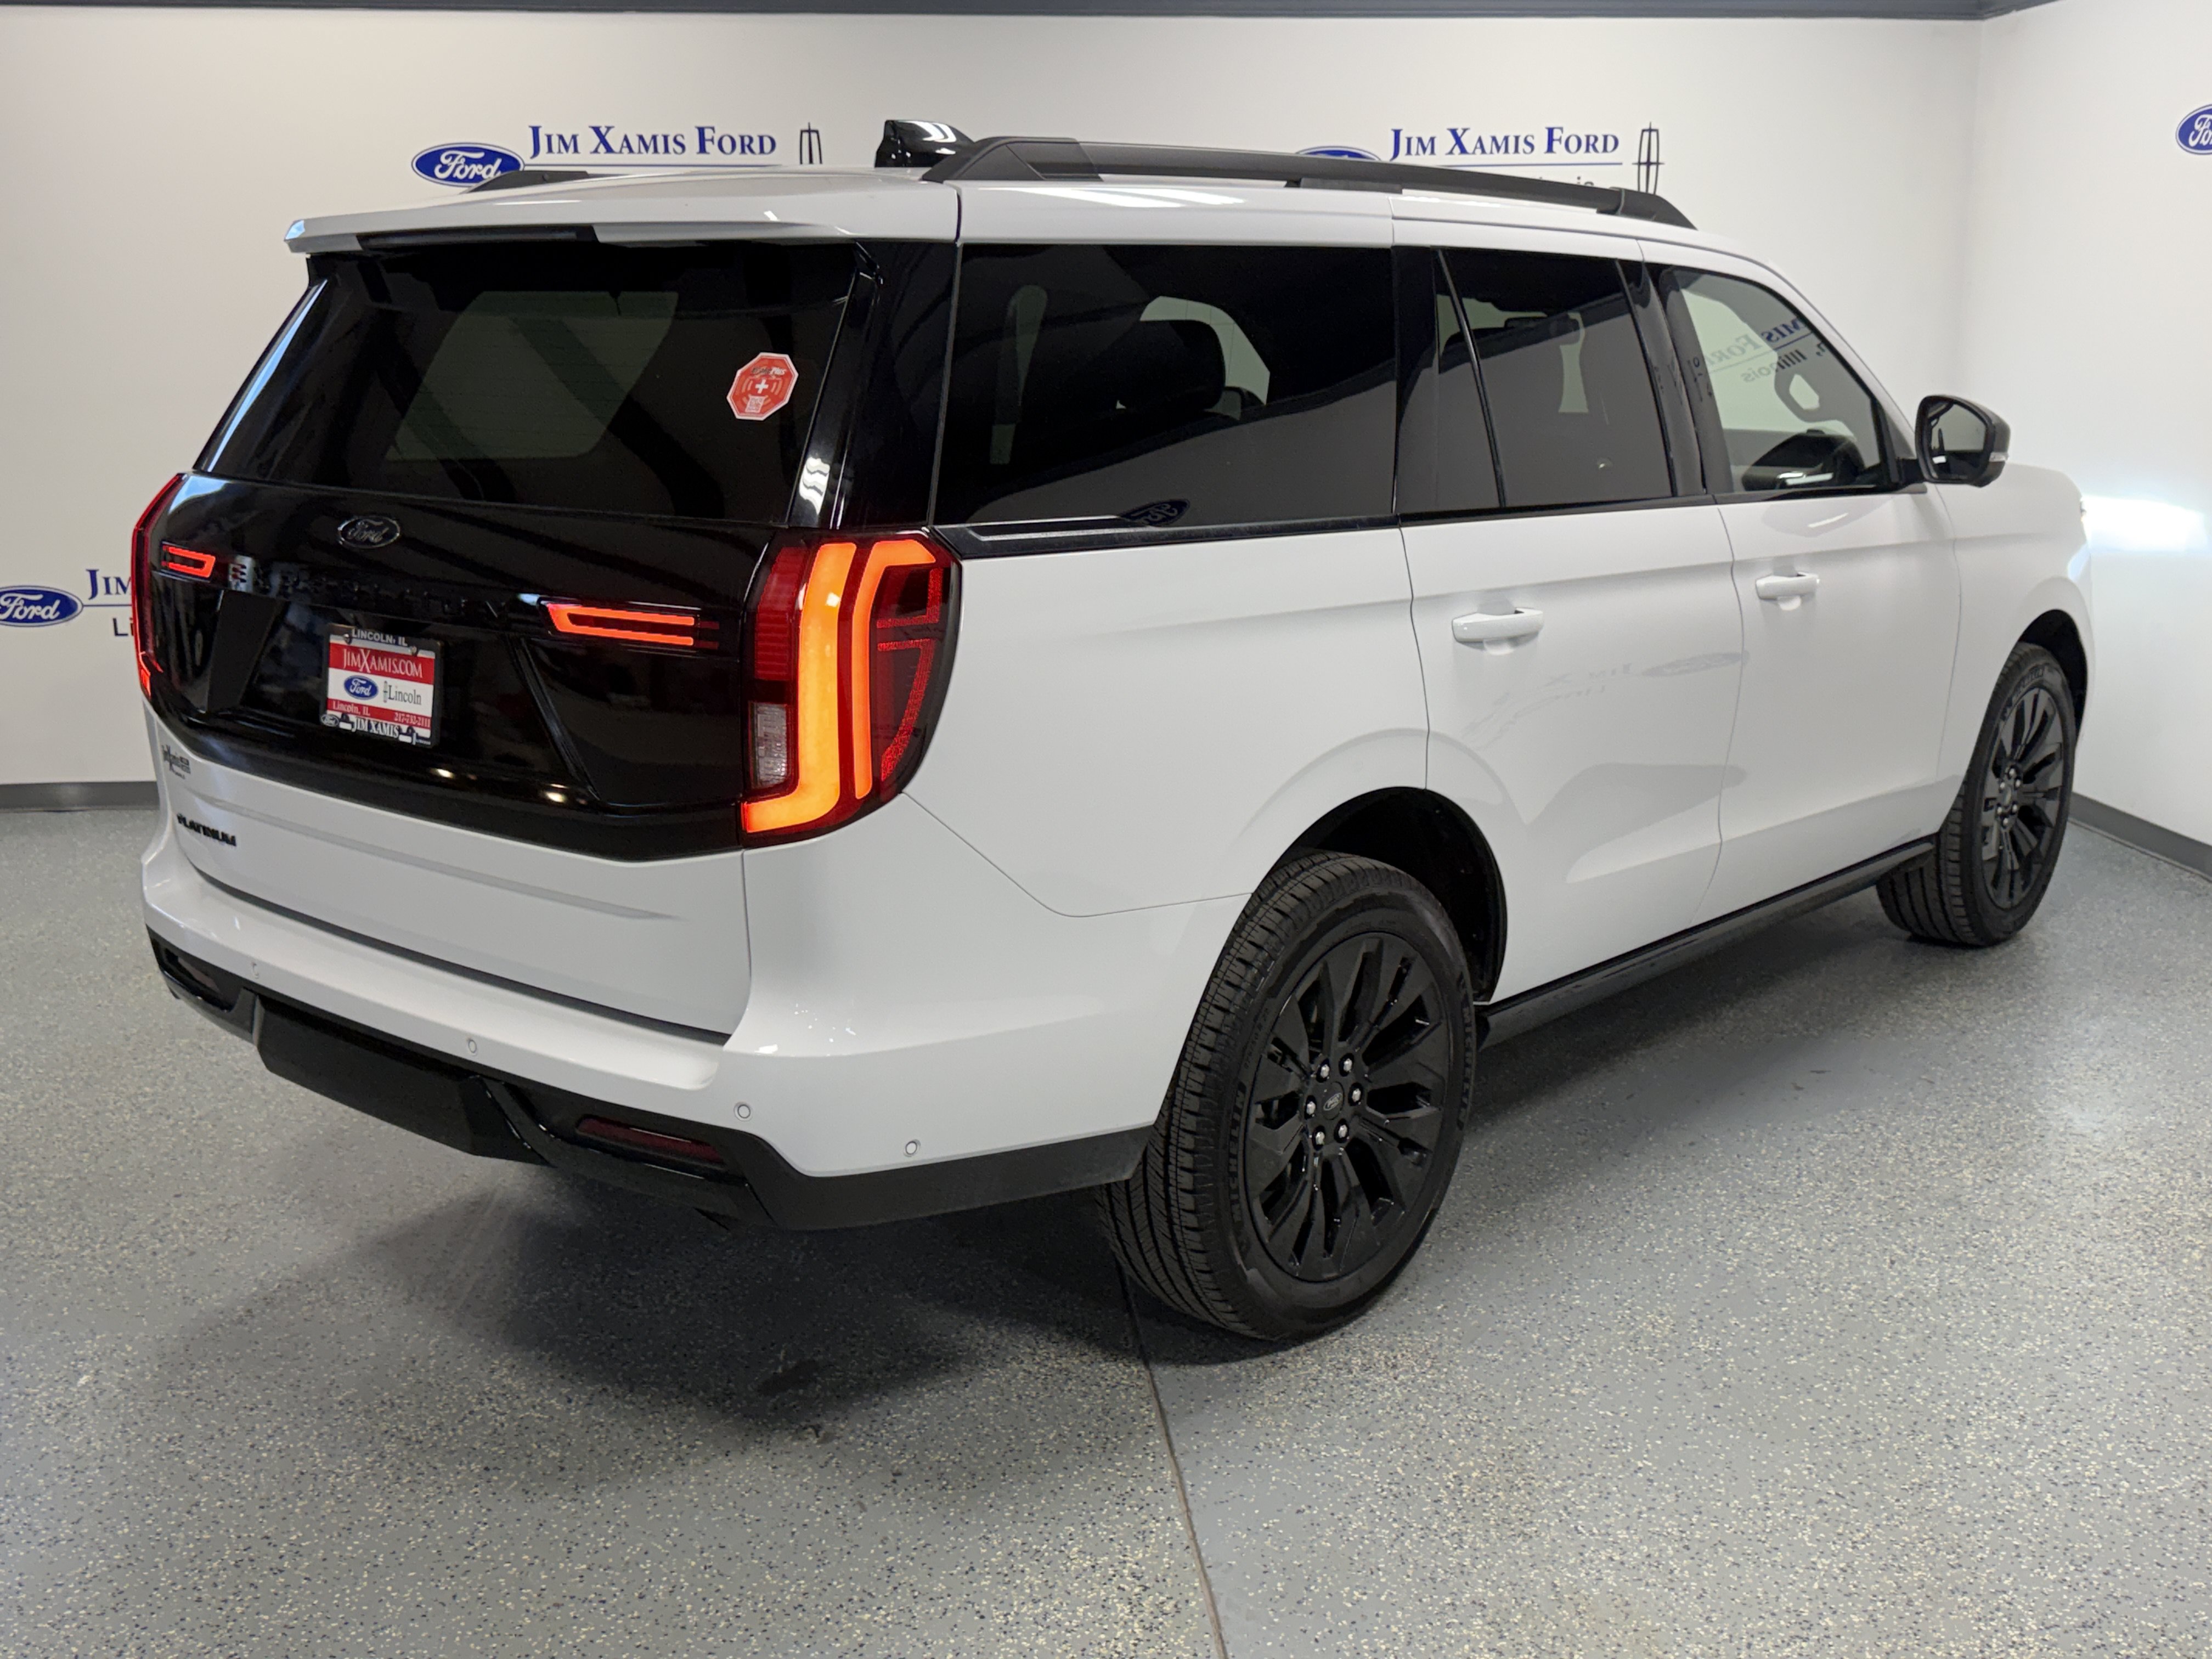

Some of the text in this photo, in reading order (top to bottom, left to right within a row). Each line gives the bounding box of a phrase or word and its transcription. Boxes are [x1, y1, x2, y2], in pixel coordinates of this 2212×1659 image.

[528, 126, 776, 159] JIM XAMIS FORD
[2188, 114, 2212, 147] Fo
[1390, 126, 1620, 162] JIM XAMIS FORD
[433, 150, 502, 179] Ford
[348, 519, 390, 543] Ford
[0, 592, 61, 620] Ford
[352, 629, 408, 646] LINCOLN, IL
[349, 678, 371, 697] Ford
[388, 684, 422, 706] Lincoln
[363, 706, 371, 716] IL
[351, 718, 369, 732] JIM
[370, 720, 399, 739] XAMIS
[177, 813, 236, 847] PLATINUM
